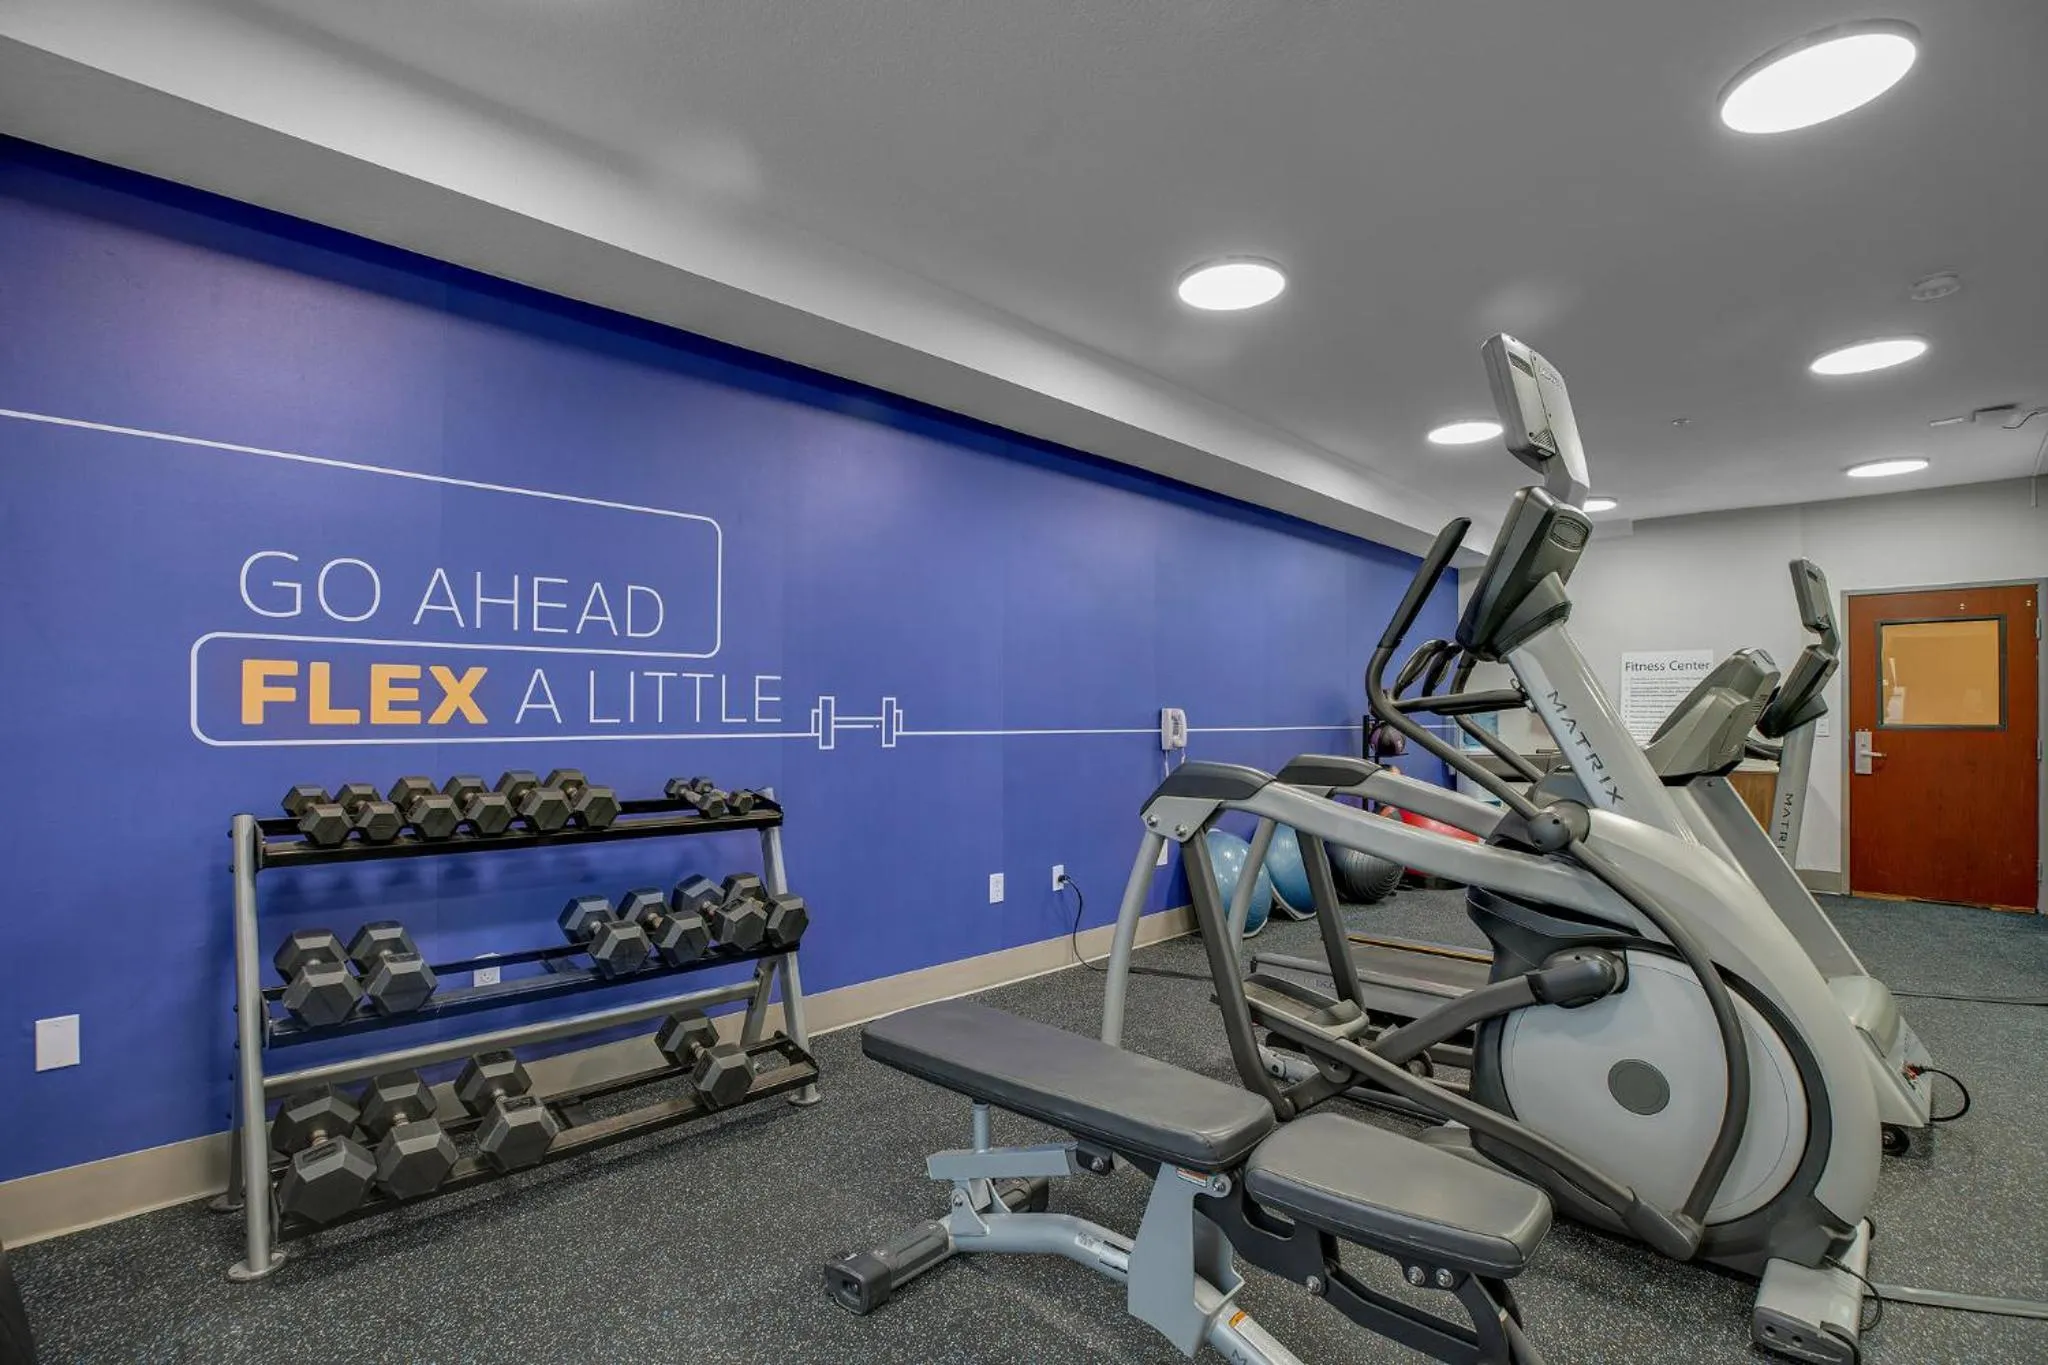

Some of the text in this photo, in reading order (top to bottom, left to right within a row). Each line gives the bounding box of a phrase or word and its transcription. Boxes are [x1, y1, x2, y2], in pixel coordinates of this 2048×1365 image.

[240, 551, 664, 638] GO AHEAD
[242, 660, 782, 725] FLEX A LITTLE
[1625, 660, 1711, 672] Fitness Center
[1546, 690, 1624, 805] MATRIX
[1777, 793, 1793, 856] MATRI
